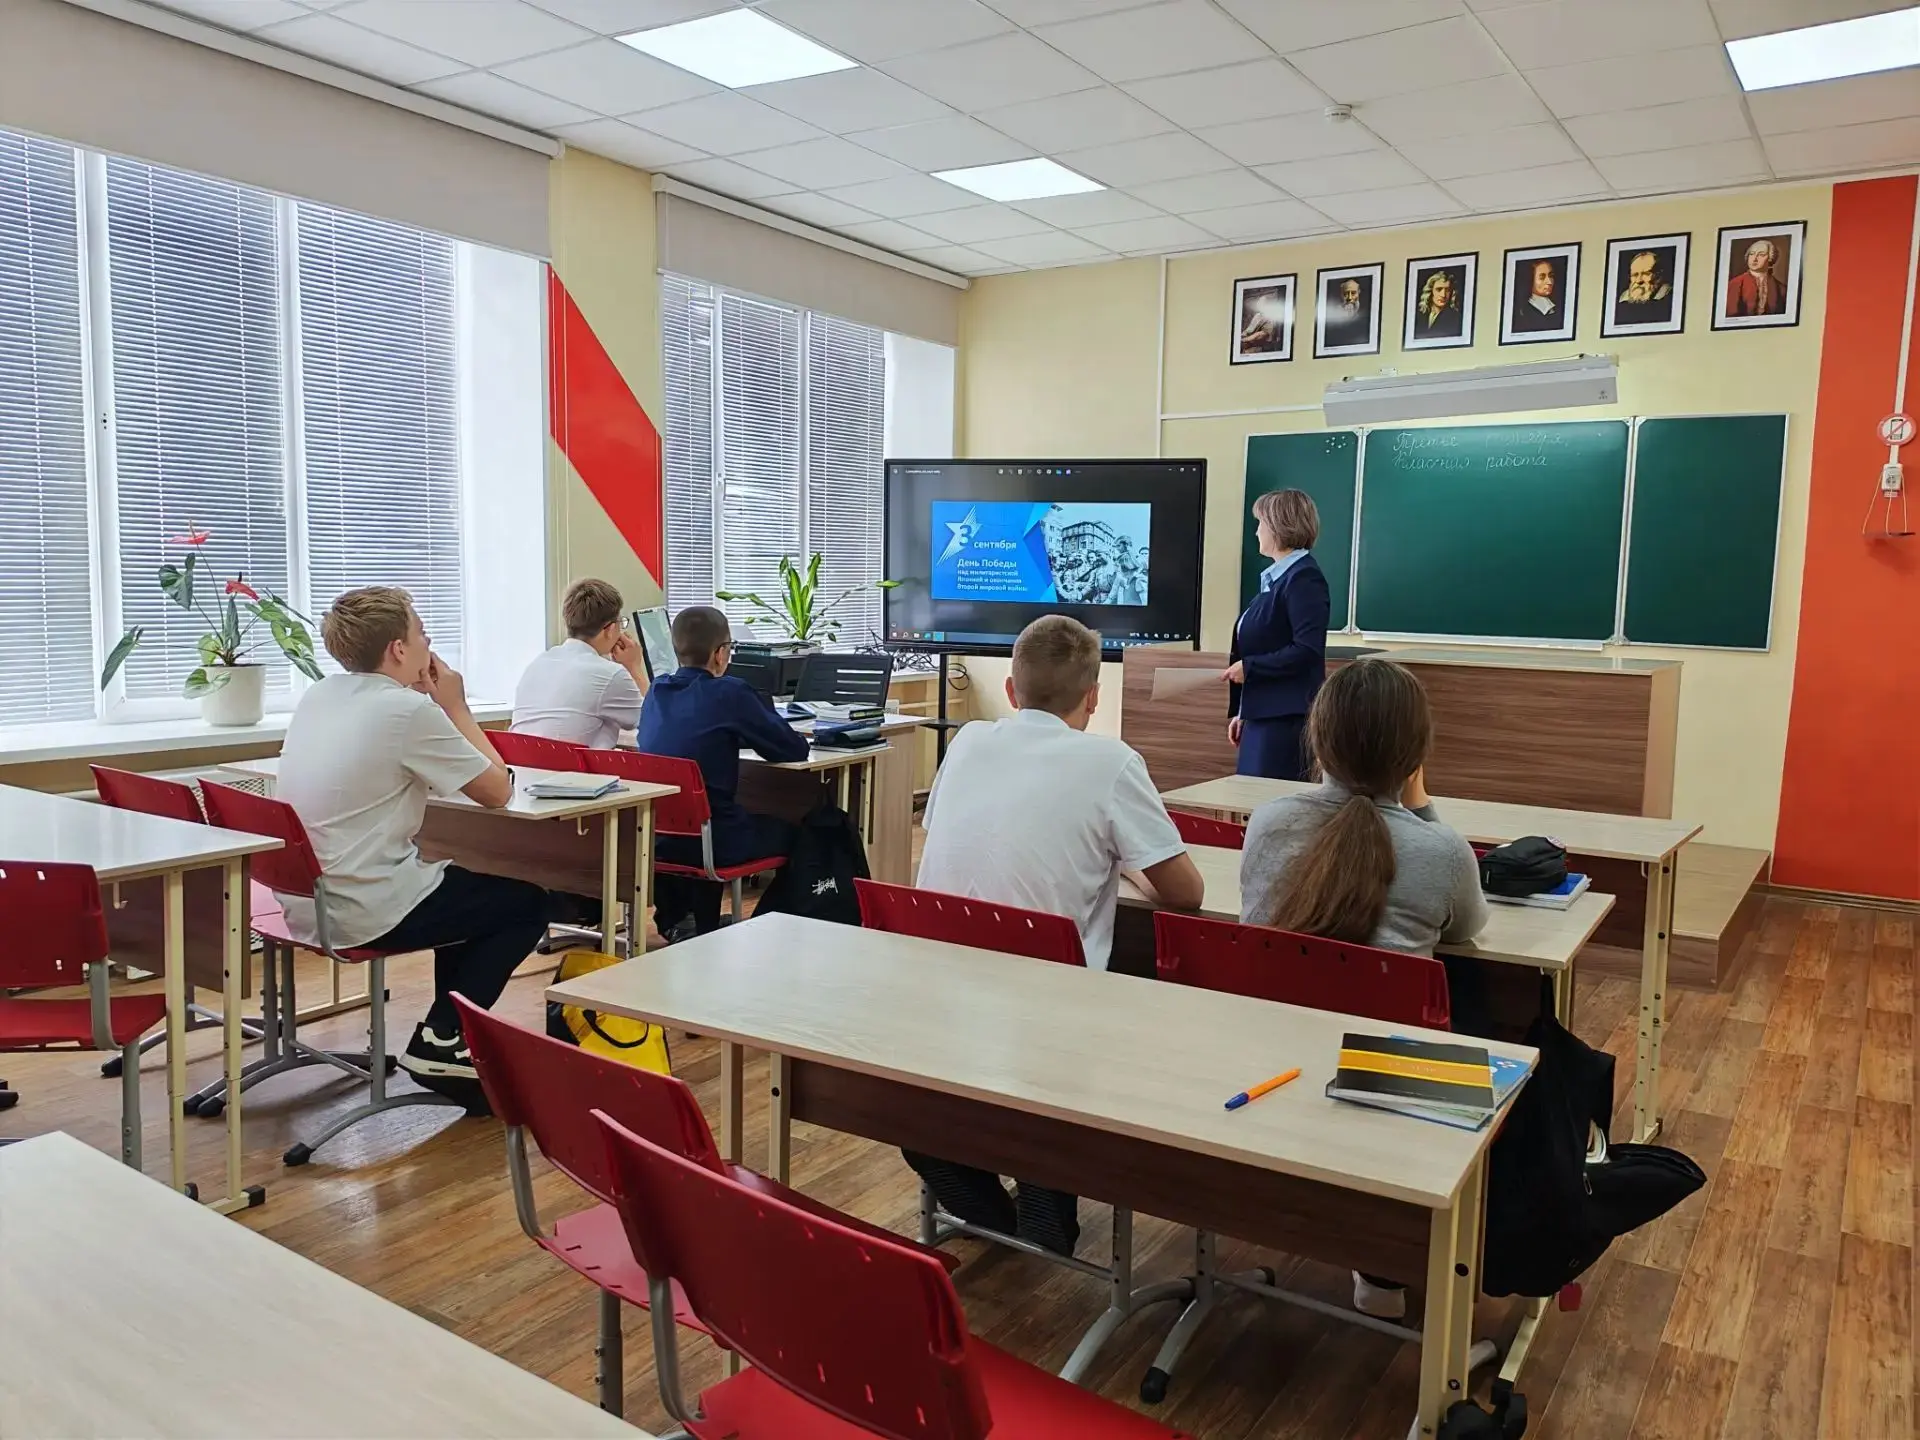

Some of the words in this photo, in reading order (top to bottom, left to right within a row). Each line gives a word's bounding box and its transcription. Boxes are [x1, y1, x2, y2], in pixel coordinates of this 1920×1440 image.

[1485, 452, 1547, 472] работа
[959, 524, 972, 546] 3
[973, 540, 1017, 551] сентября
[957, 558, 980, 568] День
[981, 559, 1017, 569] Победы
